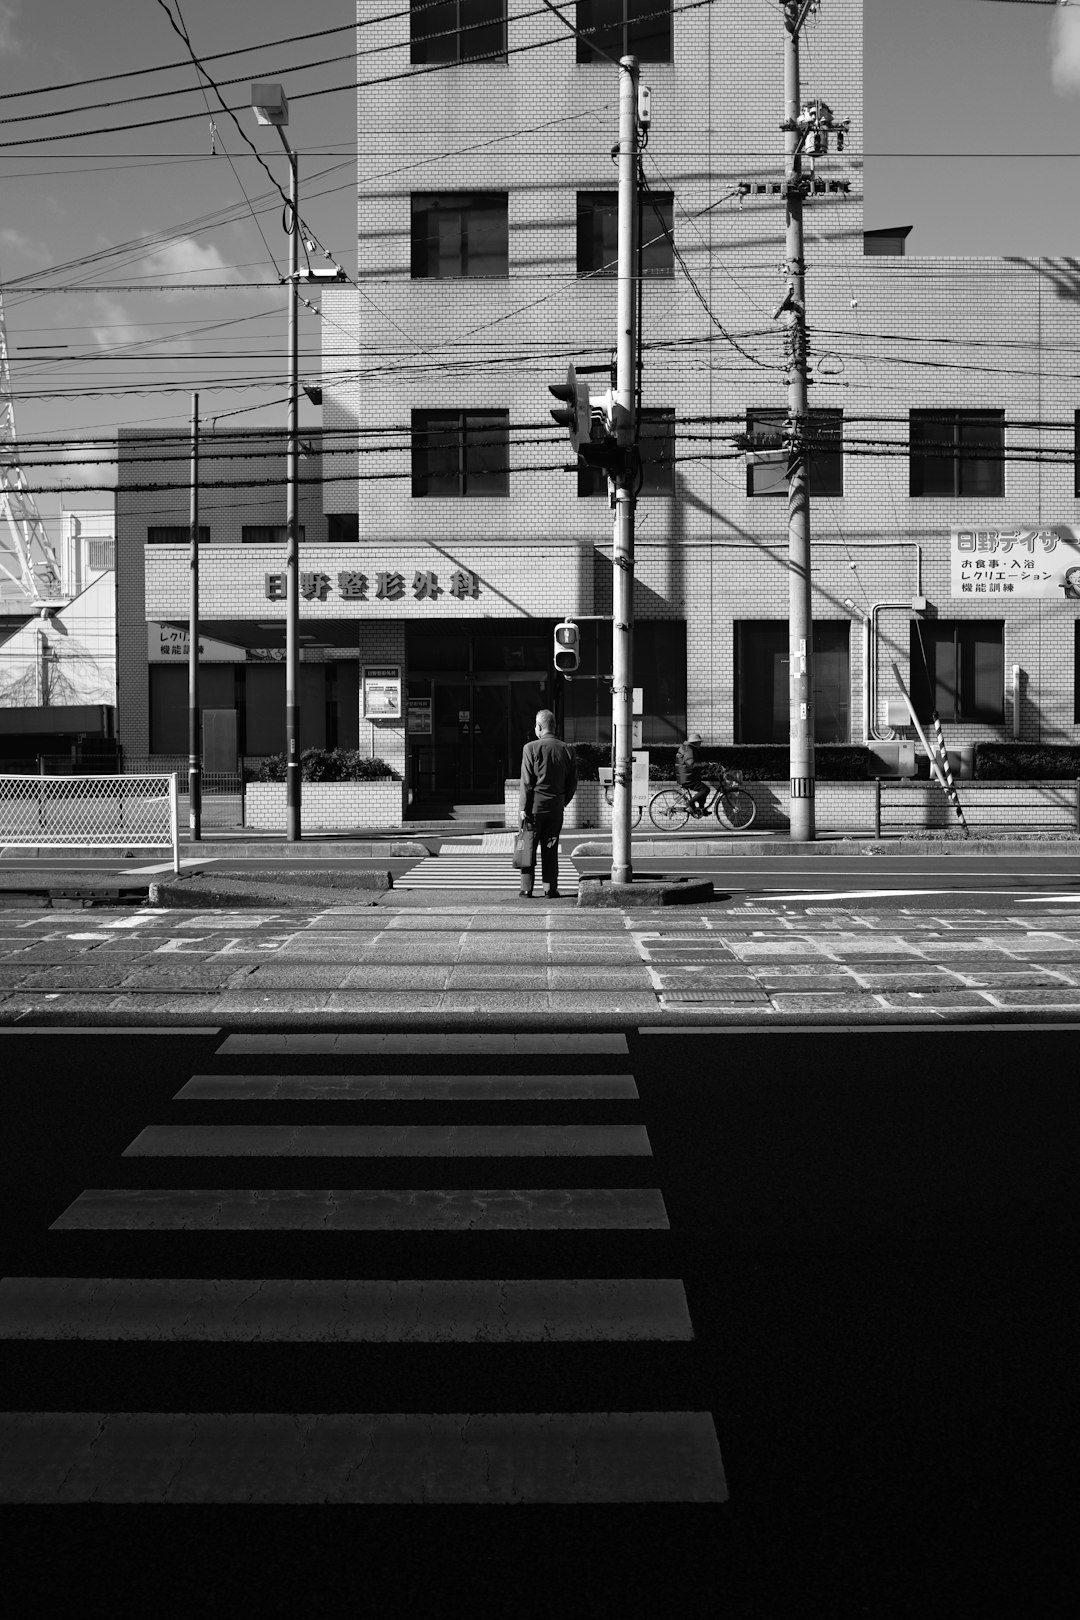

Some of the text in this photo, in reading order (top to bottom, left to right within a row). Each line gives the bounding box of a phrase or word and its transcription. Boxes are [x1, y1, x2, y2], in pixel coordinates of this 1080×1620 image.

[961, 559, 1035, 569] お食事・入浴
[961, 571, 1052, 580] レクリエーション
[264, 571, 480, 599] 日野整形外科
[961, 583, 1014, 593] 機能訓練
[160, 632, 190, 642] レクリ
